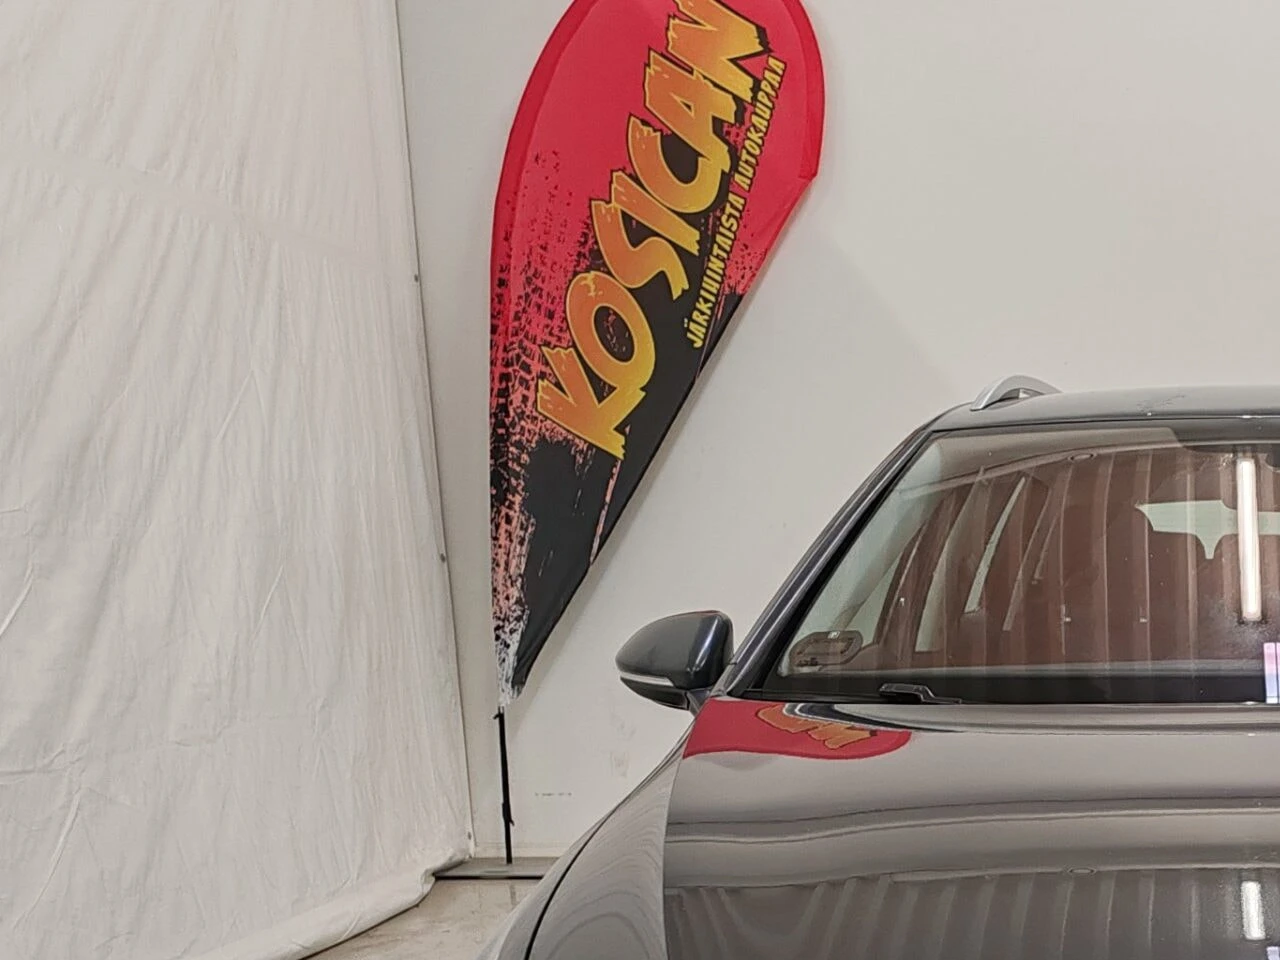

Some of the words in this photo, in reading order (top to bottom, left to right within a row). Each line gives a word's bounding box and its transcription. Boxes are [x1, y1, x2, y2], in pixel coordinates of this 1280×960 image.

[537, 0, 765, 460] KOSICAN
[683, 192, 746, 349] JÄRKIHINTAISTA
[734, 55, 787, 191] AUTOKAUPPAA
